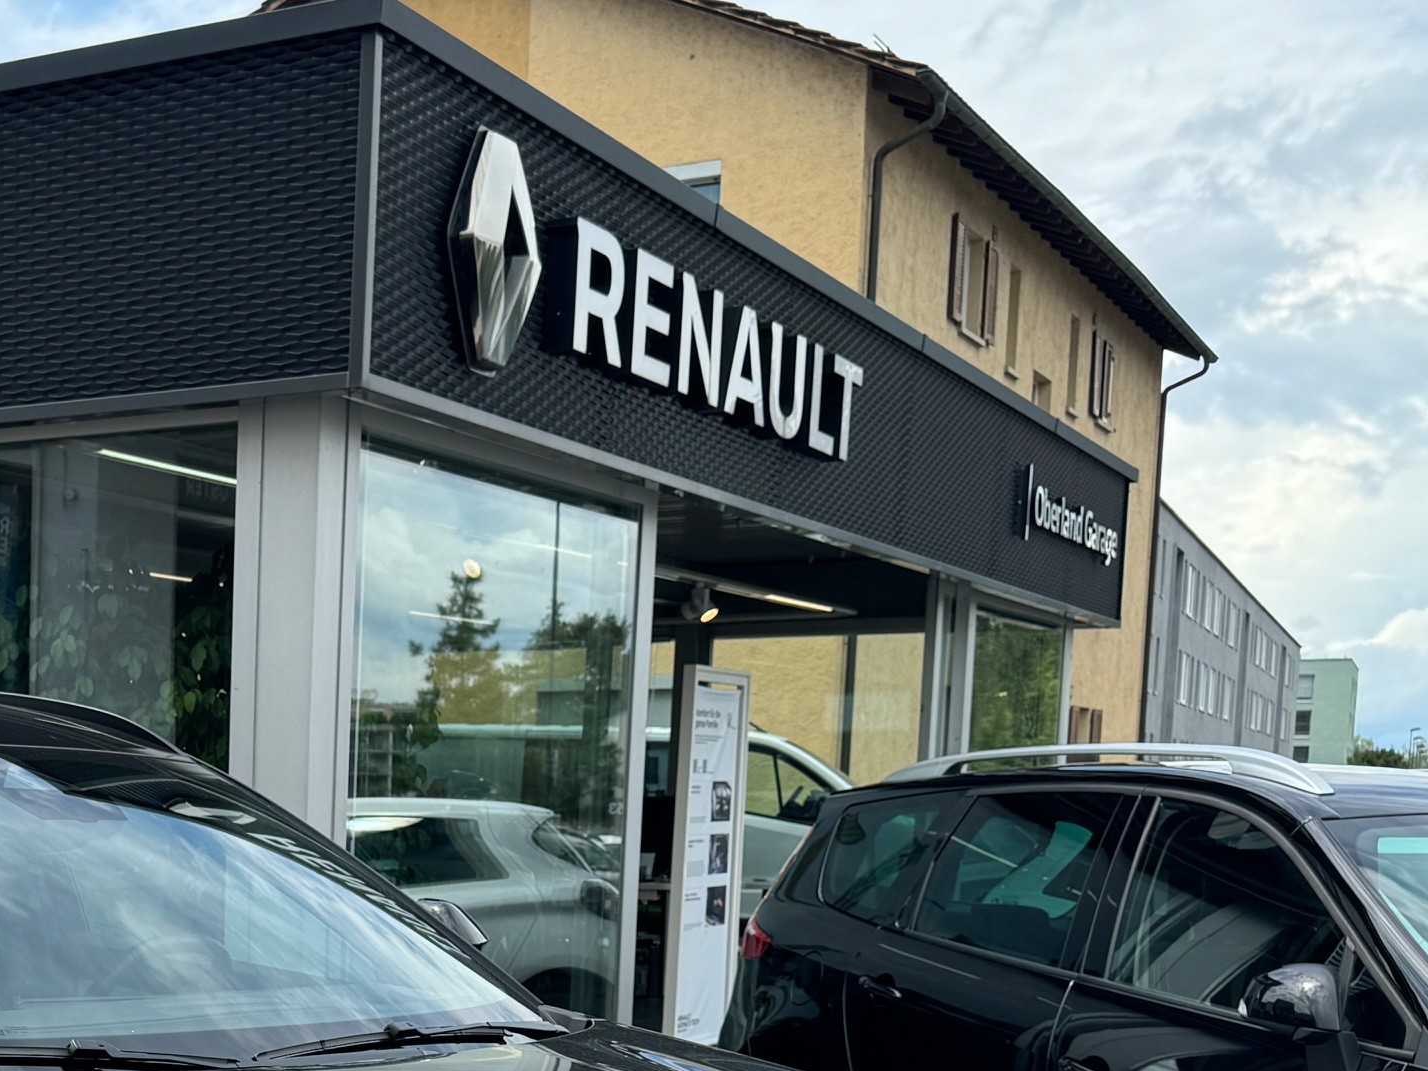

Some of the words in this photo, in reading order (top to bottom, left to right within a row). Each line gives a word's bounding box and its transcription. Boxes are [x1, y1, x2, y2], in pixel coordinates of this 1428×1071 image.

[572, 216, 864, 461] RENAULT
[1035, 485, 1084, 545] Oberland
[1084, 510, 1118, 566] Garage
